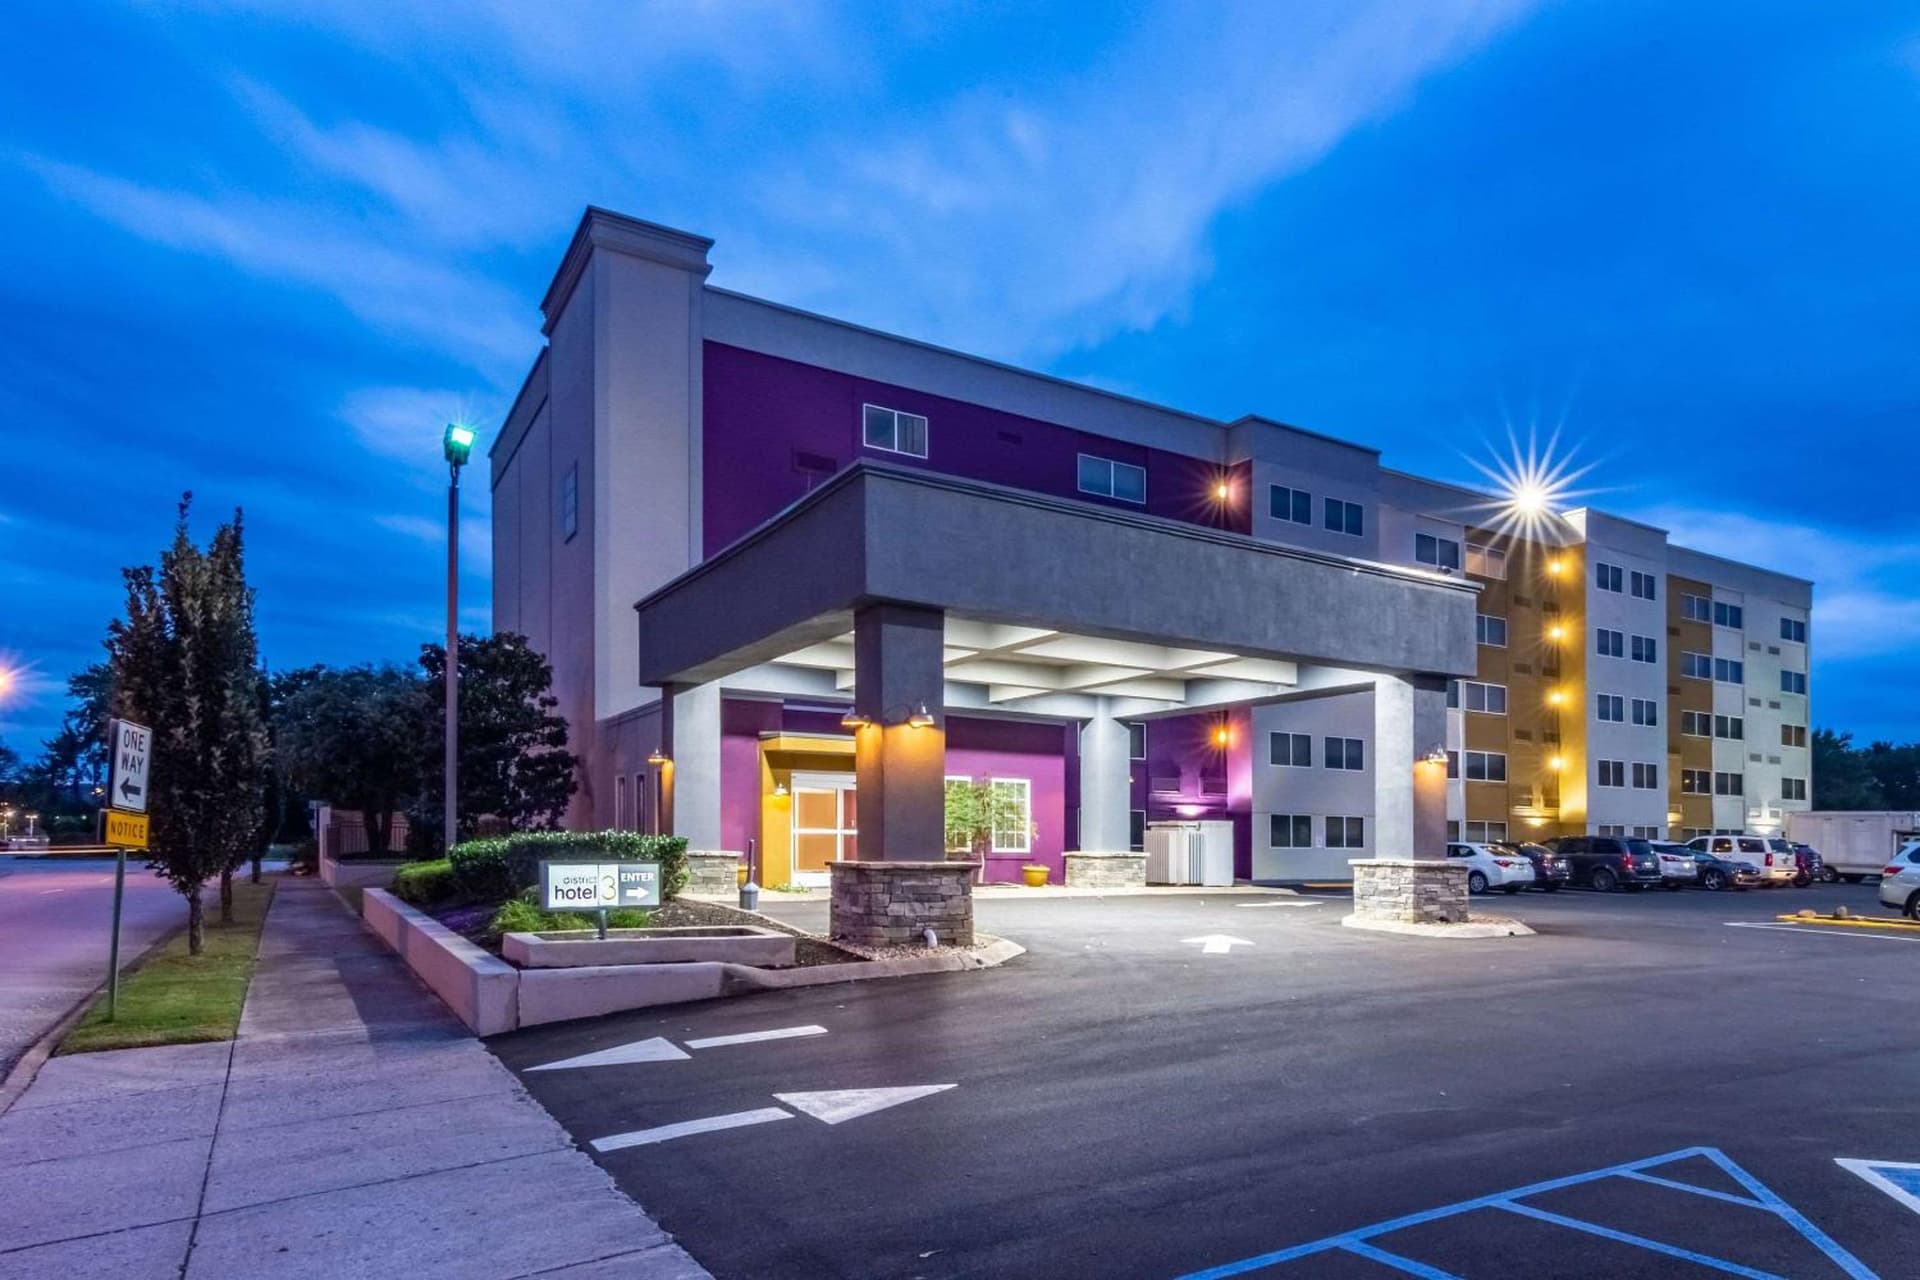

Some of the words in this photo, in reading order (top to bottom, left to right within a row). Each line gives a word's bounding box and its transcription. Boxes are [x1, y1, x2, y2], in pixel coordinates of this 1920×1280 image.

[123, 729, 145, 753] ONE
[121, 752, 144, 775] WAY
[110, 821, 145, 839] NOTICE
[563, 876, 598, 885] district
[621, 872, 655, 882] ENTER
[555, 885, 597, 900] hotel
[602, 875, 617, 901] 3
